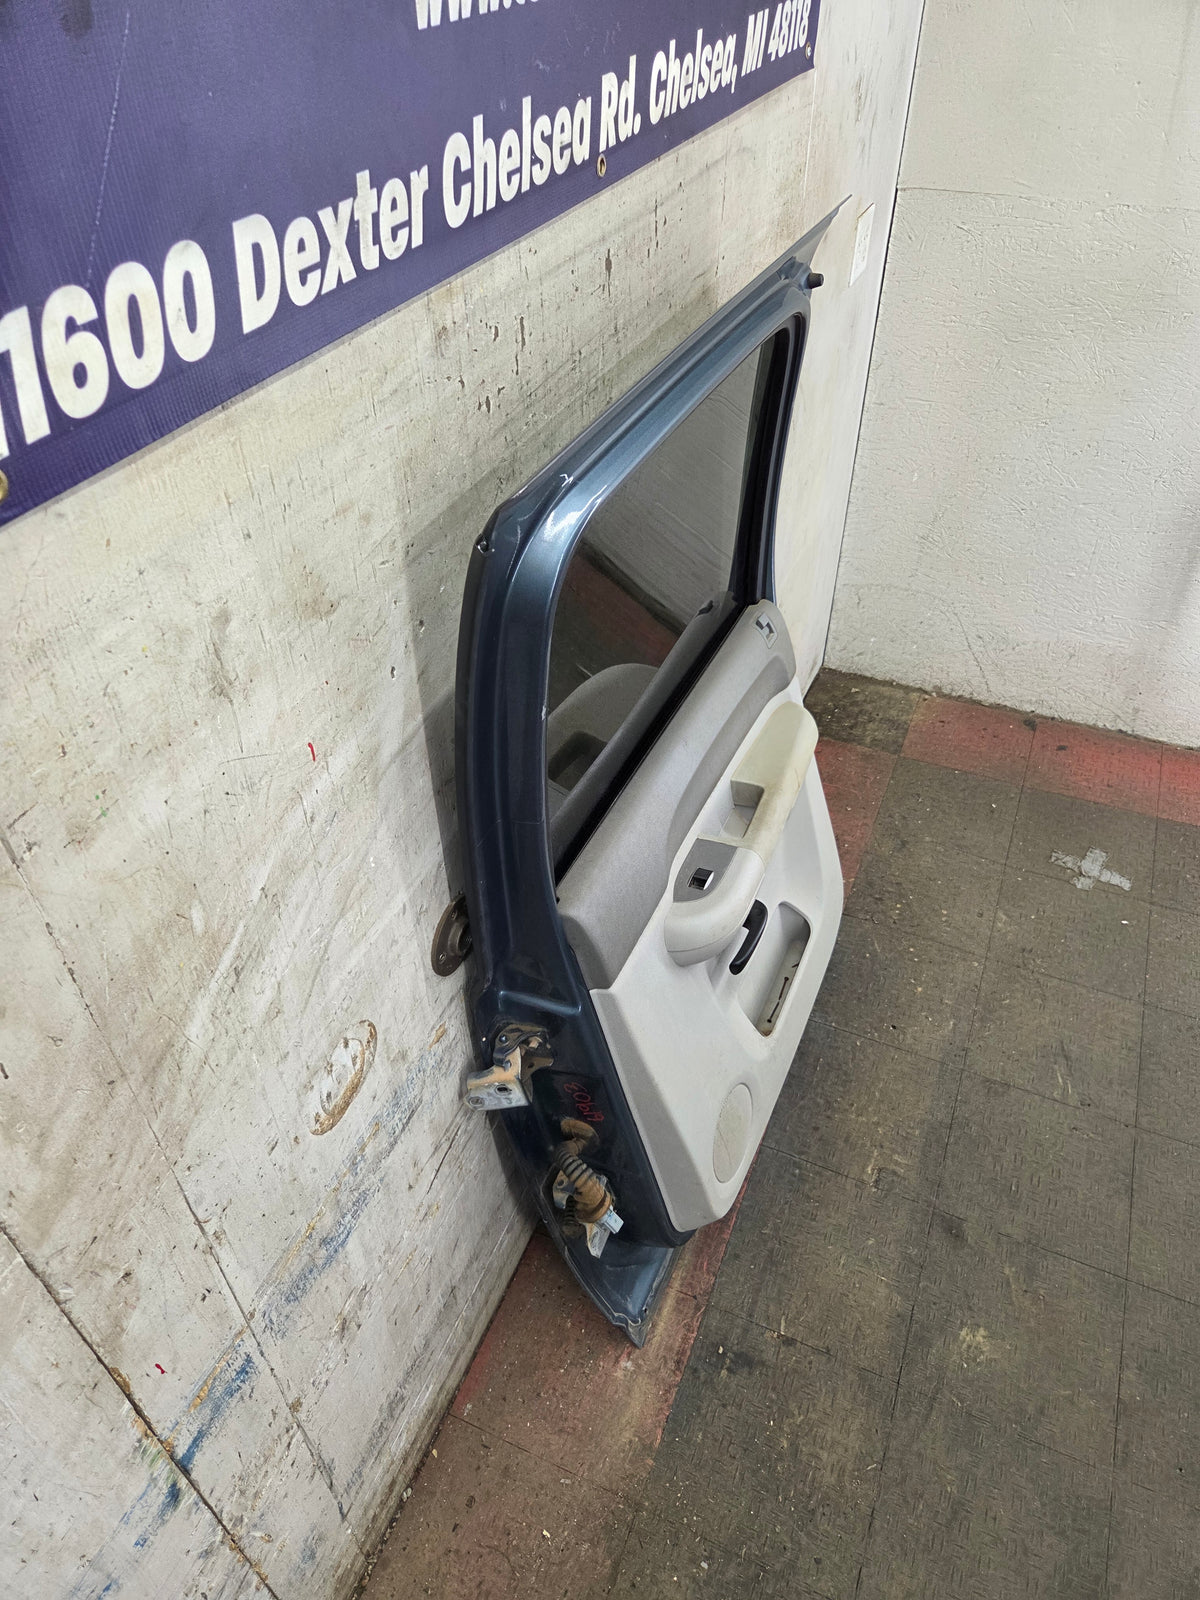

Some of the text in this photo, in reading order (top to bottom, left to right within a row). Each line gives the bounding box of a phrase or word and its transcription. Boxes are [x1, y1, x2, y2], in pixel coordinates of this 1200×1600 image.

[232, 164, 429, 335] Dexter
[442, 95, 592, 229] Chelsea
[599, 54, 642, 153] Rd.
[649, 28, 738, 125] Chelsea,
[741, 8, 769, 77] MI
[767, 0, 812, 62] 48118
